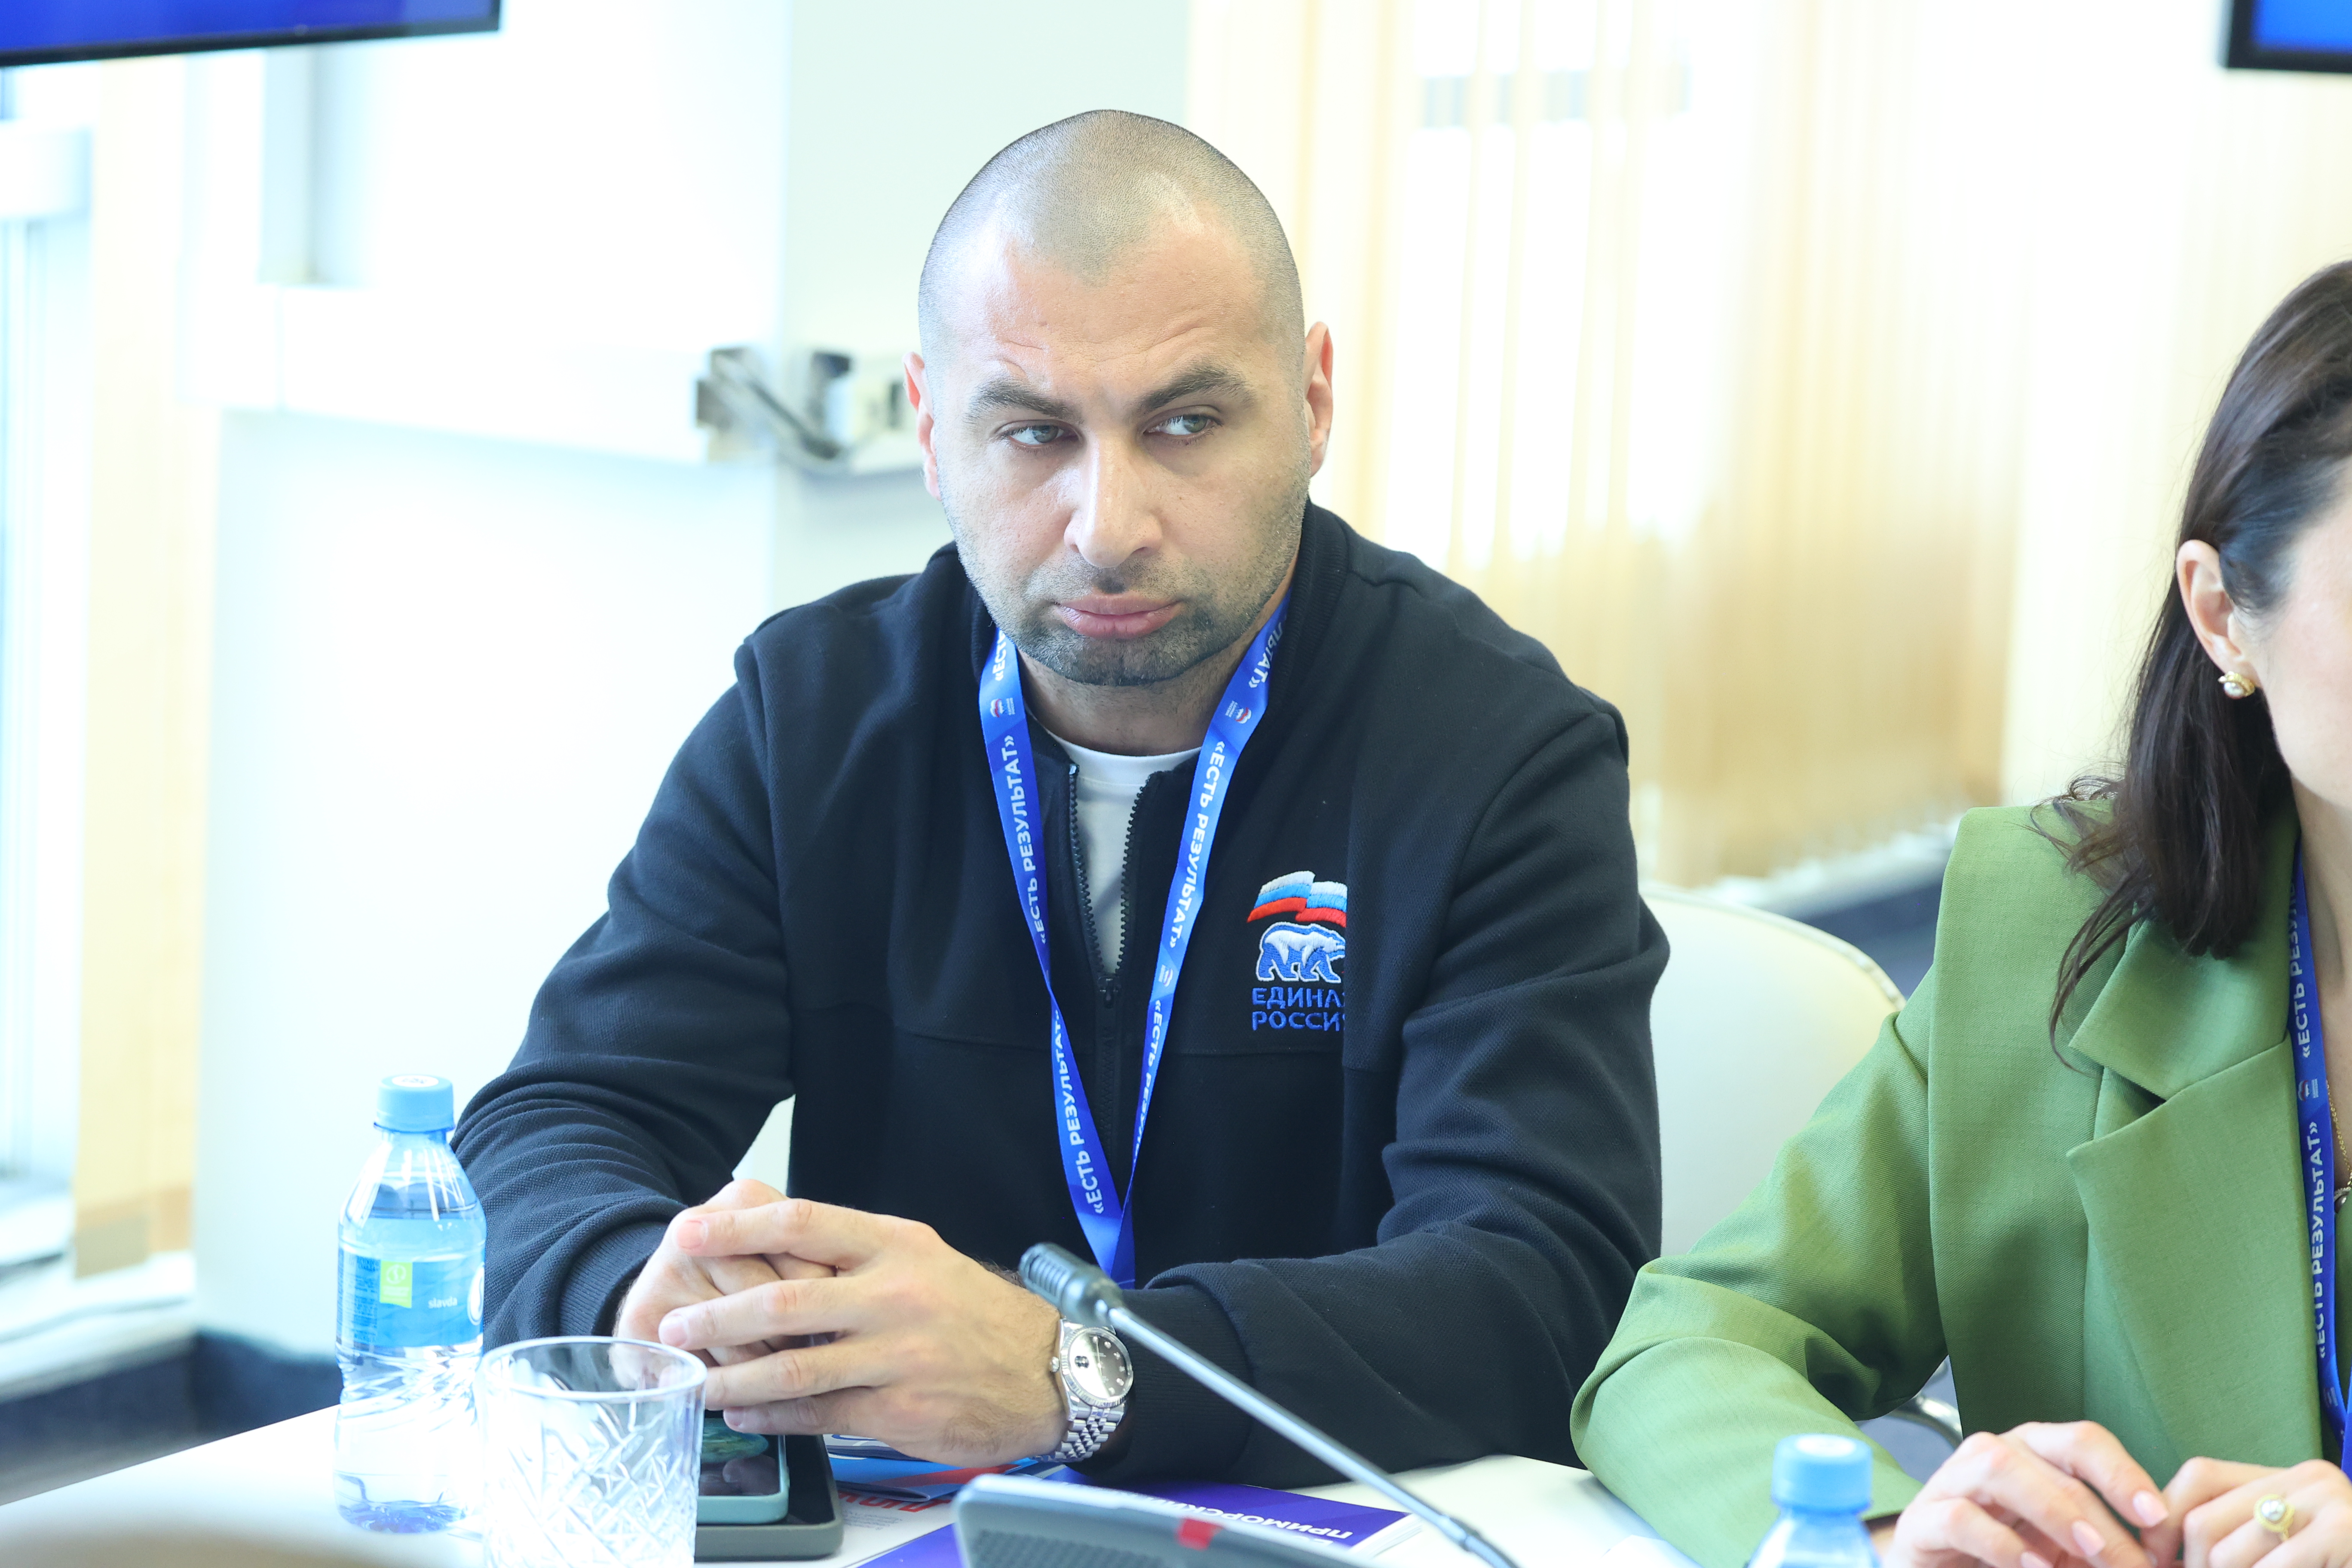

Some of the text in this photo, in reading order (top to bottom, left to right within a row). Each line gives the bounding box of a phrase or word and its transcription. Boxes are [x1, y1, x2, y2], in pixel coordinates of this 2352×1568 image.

[1249, 622, 1283, 688] ЛЬТАТ»
[1001, 735, 1046, 944] «ЕСТЬ РЕЗУЛЬТАТ»
[1170, 741, 1225, 948] «ЕСТЬ РЕЗУЛЬТАТ»
[1148, 999, 1163, 1067] «ЕСТЬ
[1252, 986, 1345, 1010] ЕДИНА
[1252, 1011, 1345, 1032] РОССИ
[2294, 983, 2311, 1058] «ЕСТЬ
[1055, 1010, 1105, 1214] «ЕСТЬ РЕЗУЛЬТАТ»
[2307, 1121, 2324, 1275] РЕЗУЛЬТАТ»
[428, 1295, 458, 1309] slavda
